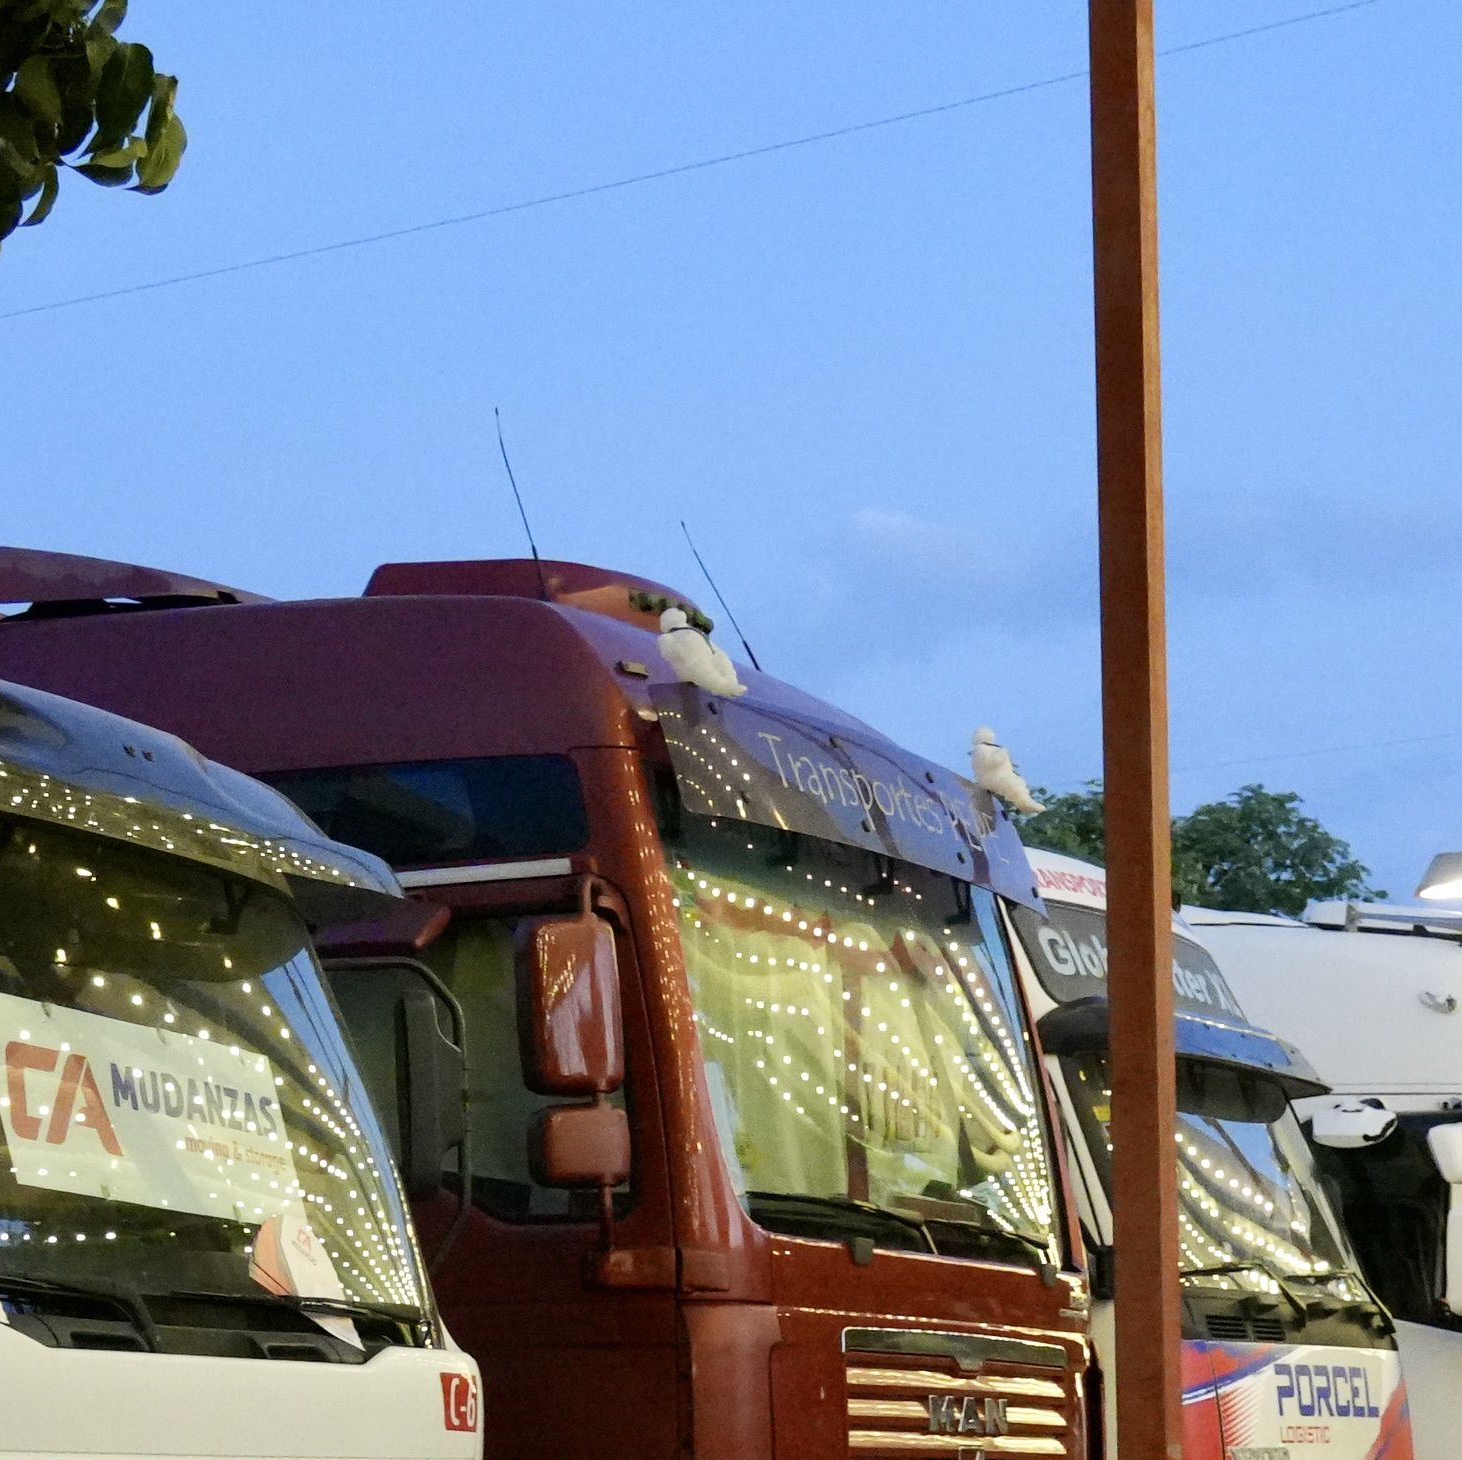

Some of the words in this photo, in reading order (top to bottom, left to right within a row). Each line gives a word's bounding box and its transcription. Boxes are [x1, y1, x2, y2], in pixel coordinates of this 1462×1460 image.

[758, 731, 943, 833] Transportes
[5, 1041, 123, 1156] CA
[110, 1062, 277, 1136] MUDANZAS
[185, 1135, 229, 1162] moving
[246, 1146, 287, 1175] storage
[928, 1394, 1009, 1434] MAN
[1274, 1363, 1379, 1418] PORCEL
[1281, 1426, 1331, 1443] LOGISTIC
